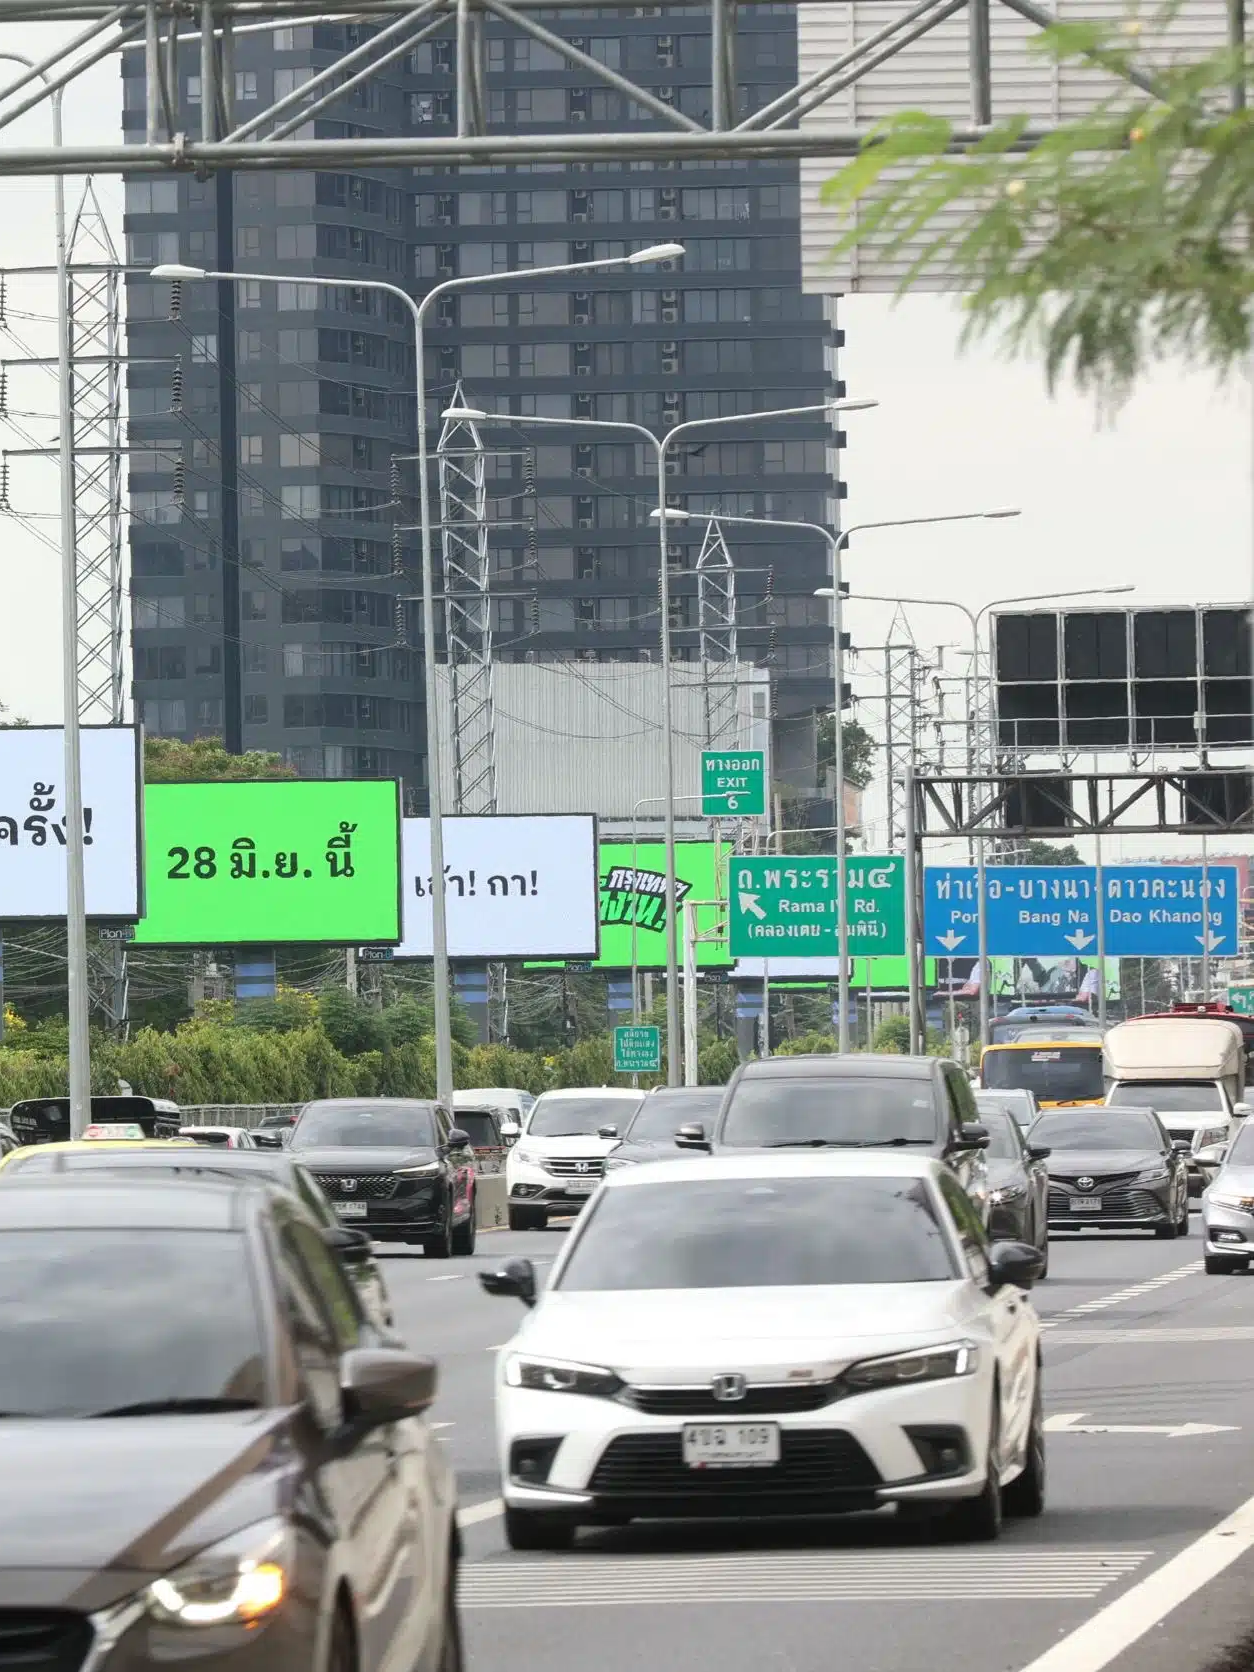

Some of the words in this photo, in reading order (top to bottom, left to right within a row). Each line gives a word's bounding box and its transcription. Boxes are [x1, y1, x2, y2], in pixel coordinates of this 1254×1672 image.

[705, 758, 760, 772] ทางออก
[717, 777, 749, 788] EXIT
[727, 794, 739, 809] 6
[167, 845, 217, 880] 28
[229, 836, 313, 880] มิ.ย.
[324, 820, 359, 879] นี้
[486, 869, 538, 897] กา!
[737, 861, 896, 890] ถ.พระรม๔
[778, 899, 825, 913] Rama
[854, 898, 880, 913] Rd.
[950, 910, 979, 924] Por
[1018, 909, 1061, 927] Bang
[1067, 909, 1090, 924] Na
[1109, 909, 1142, 924] Dao
